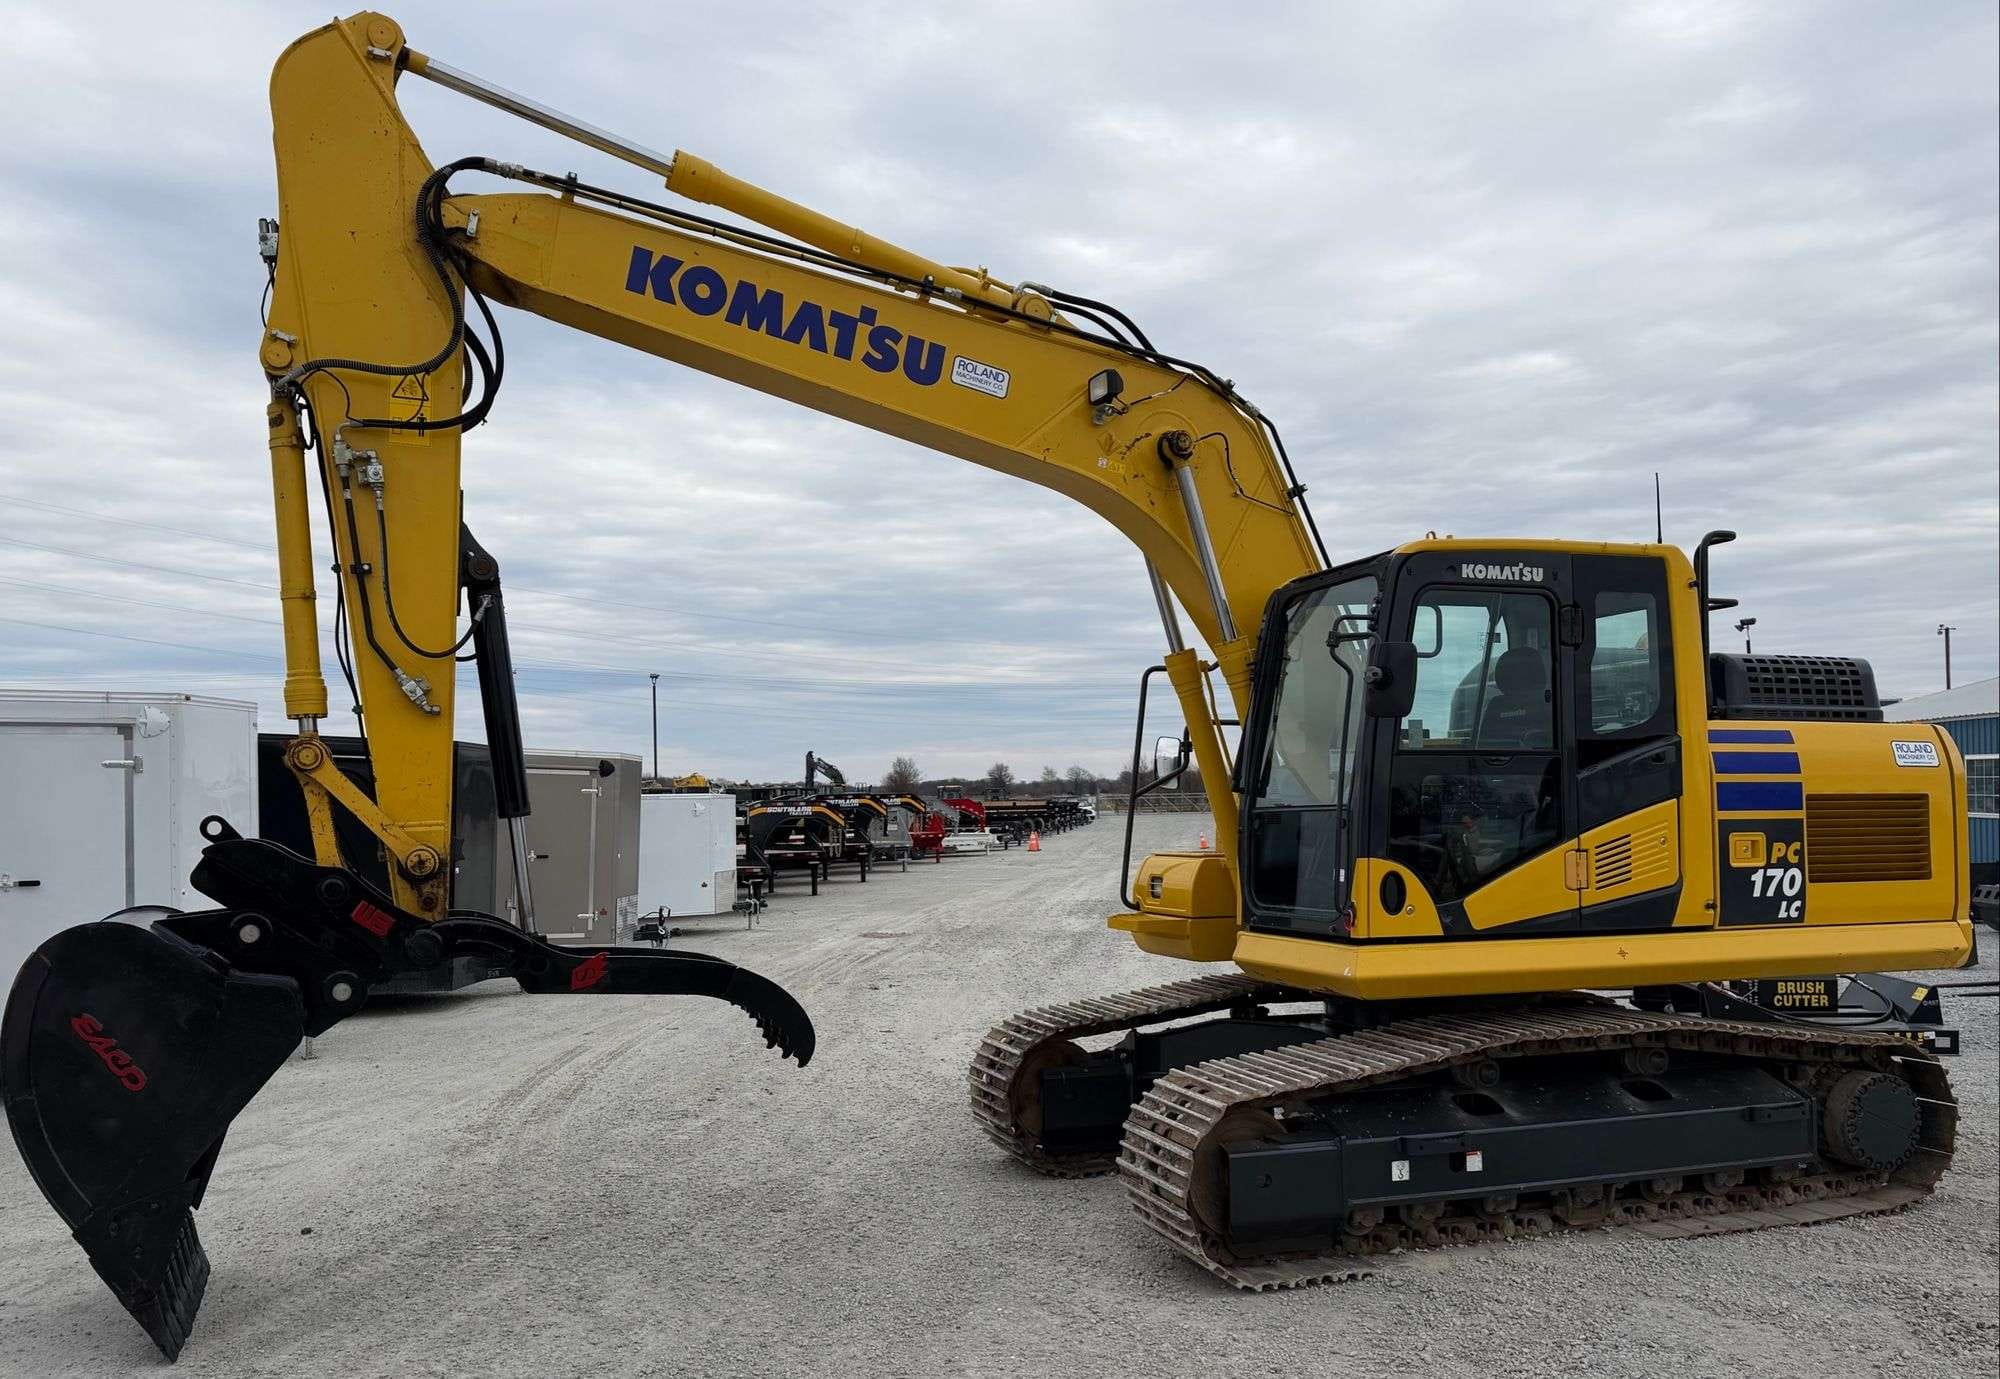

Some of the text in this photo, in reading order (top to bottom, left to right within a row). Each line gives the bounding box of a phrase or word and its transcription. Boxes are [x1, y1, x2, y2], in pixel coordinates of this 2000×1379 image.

[625, 245, 947, 387] KOMATSU
[957, 359, 1005, 383] ROLAND
[1461, 562, 1544, 582] KOMATSU
[1894, 743, 1933, 754] ROLAND
[1770, 841, 1801, 864] PC
[1750, 867, 1803, 898] 170
[1777, 900, 1802, 918] LC
[1777, 981, 1825, 994] BRUSH
[1773, 994, 1829, 1007] CUTTER
